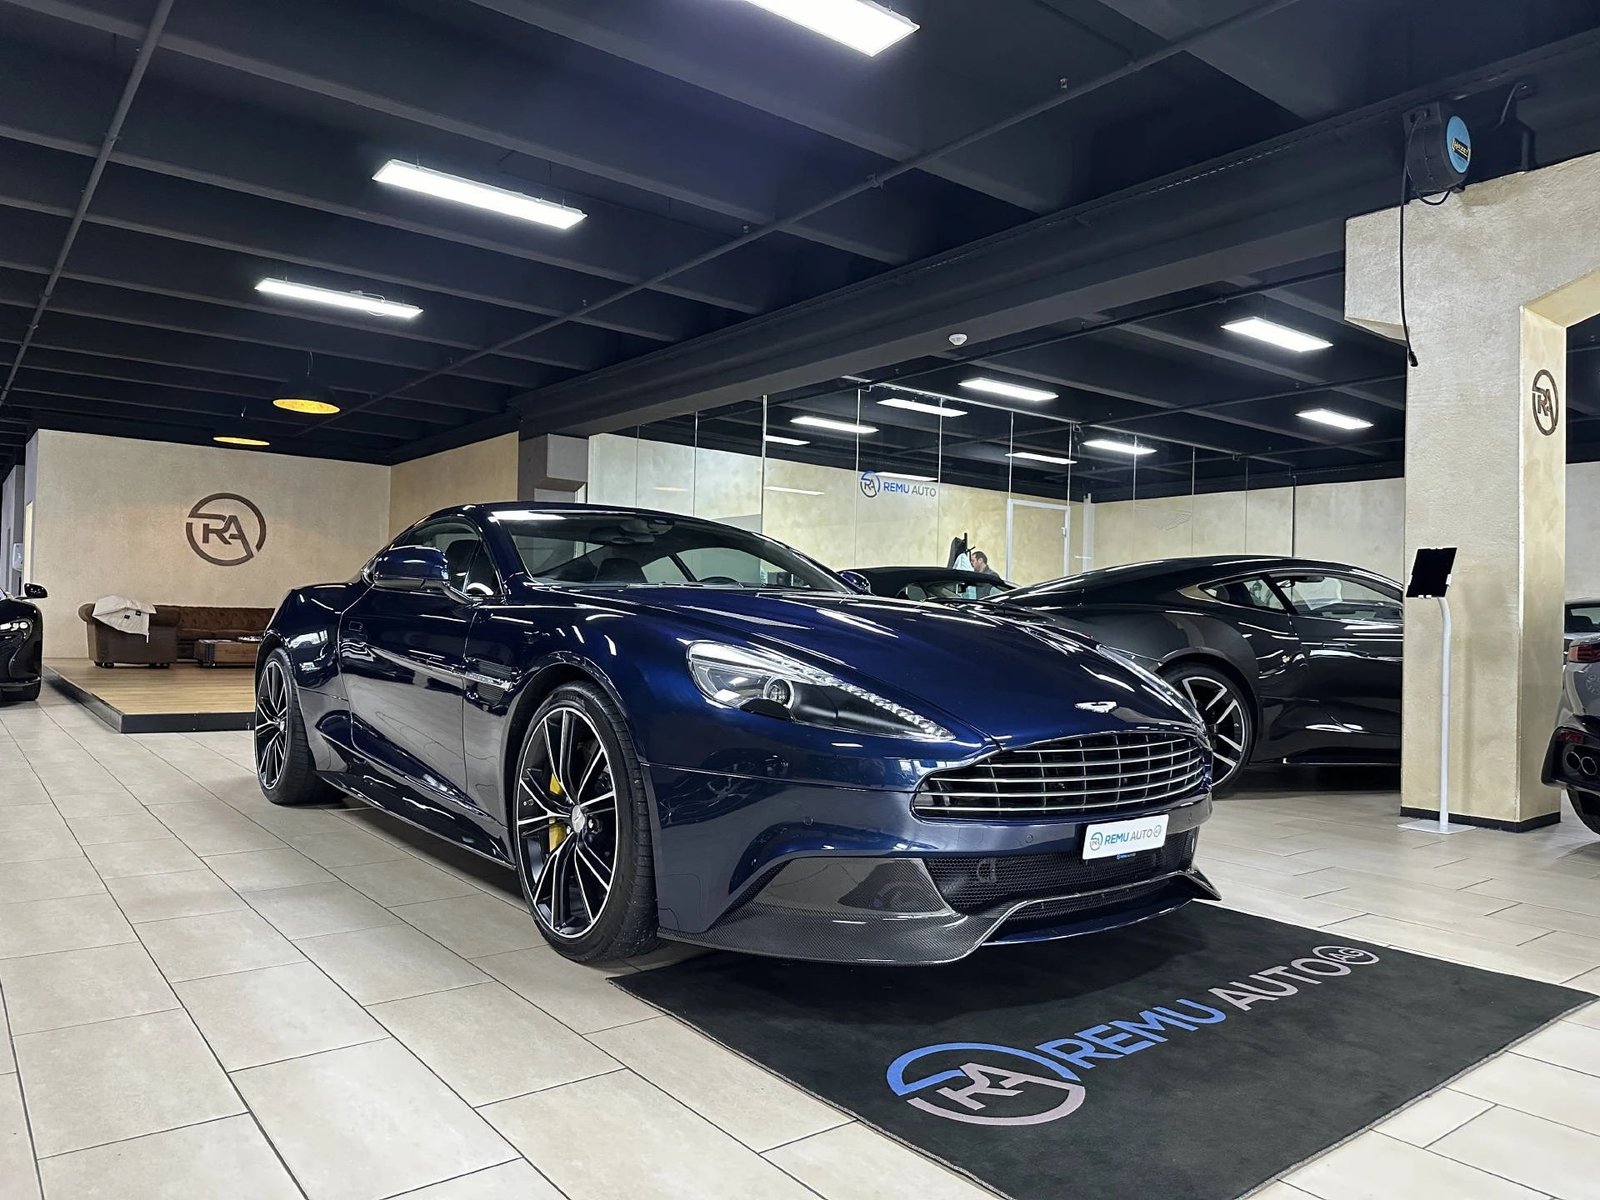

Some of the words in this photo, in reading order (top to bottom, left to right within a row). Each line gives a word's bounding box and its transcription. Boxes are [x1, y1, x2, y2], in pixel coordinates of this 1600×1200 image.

[1532, 386, 1558, 428] RA
[883, 481, 910, 494] REMU
[911, 486, 937, 497] AUTO
[188, 512, 254, 559] RA
[1104, 832, 1130, 845] REMU
[1130, 828, 1153, 841] AUTO
[1034, 998, 1227, 1069] REMU
[1207, 957, 1352, 1012] AUTO
